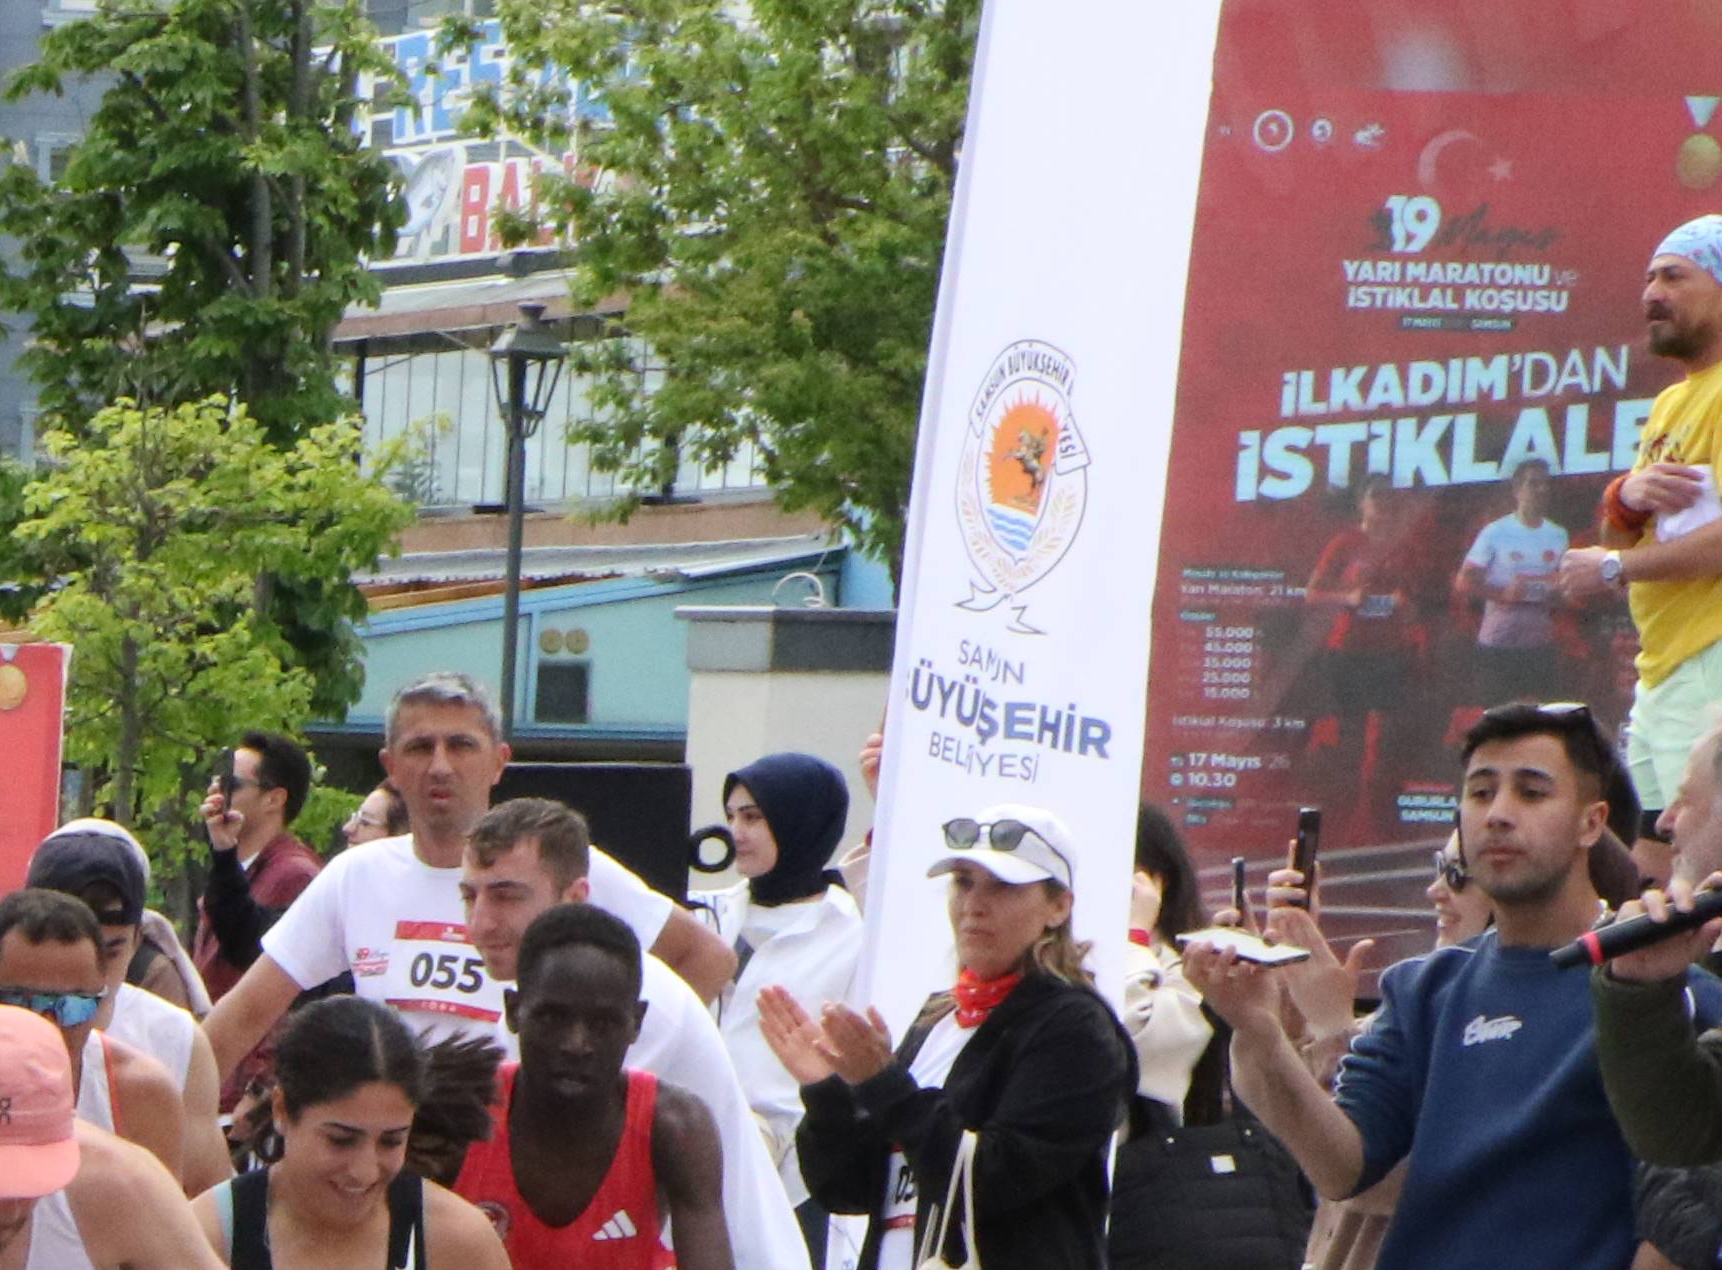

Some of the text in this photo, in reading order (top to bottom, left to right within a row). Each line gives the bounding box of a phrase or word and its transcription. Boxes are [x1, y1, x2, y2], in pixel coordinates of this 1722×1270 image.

[1385, 195, 1442, 253] 19
[1343, 260, 1401, 283] YARI
[1406, 261, 1551, 286] MARATONU
[1464, 288, 1570, 313] KOŞUSU
[906, 657, 1112, 760] ÜYÜŞEHİR
[1188, 752, 1207, 766] 17
[1188, 772, 1237, 787] 10.30
[410, 952, 486, 993] 055
